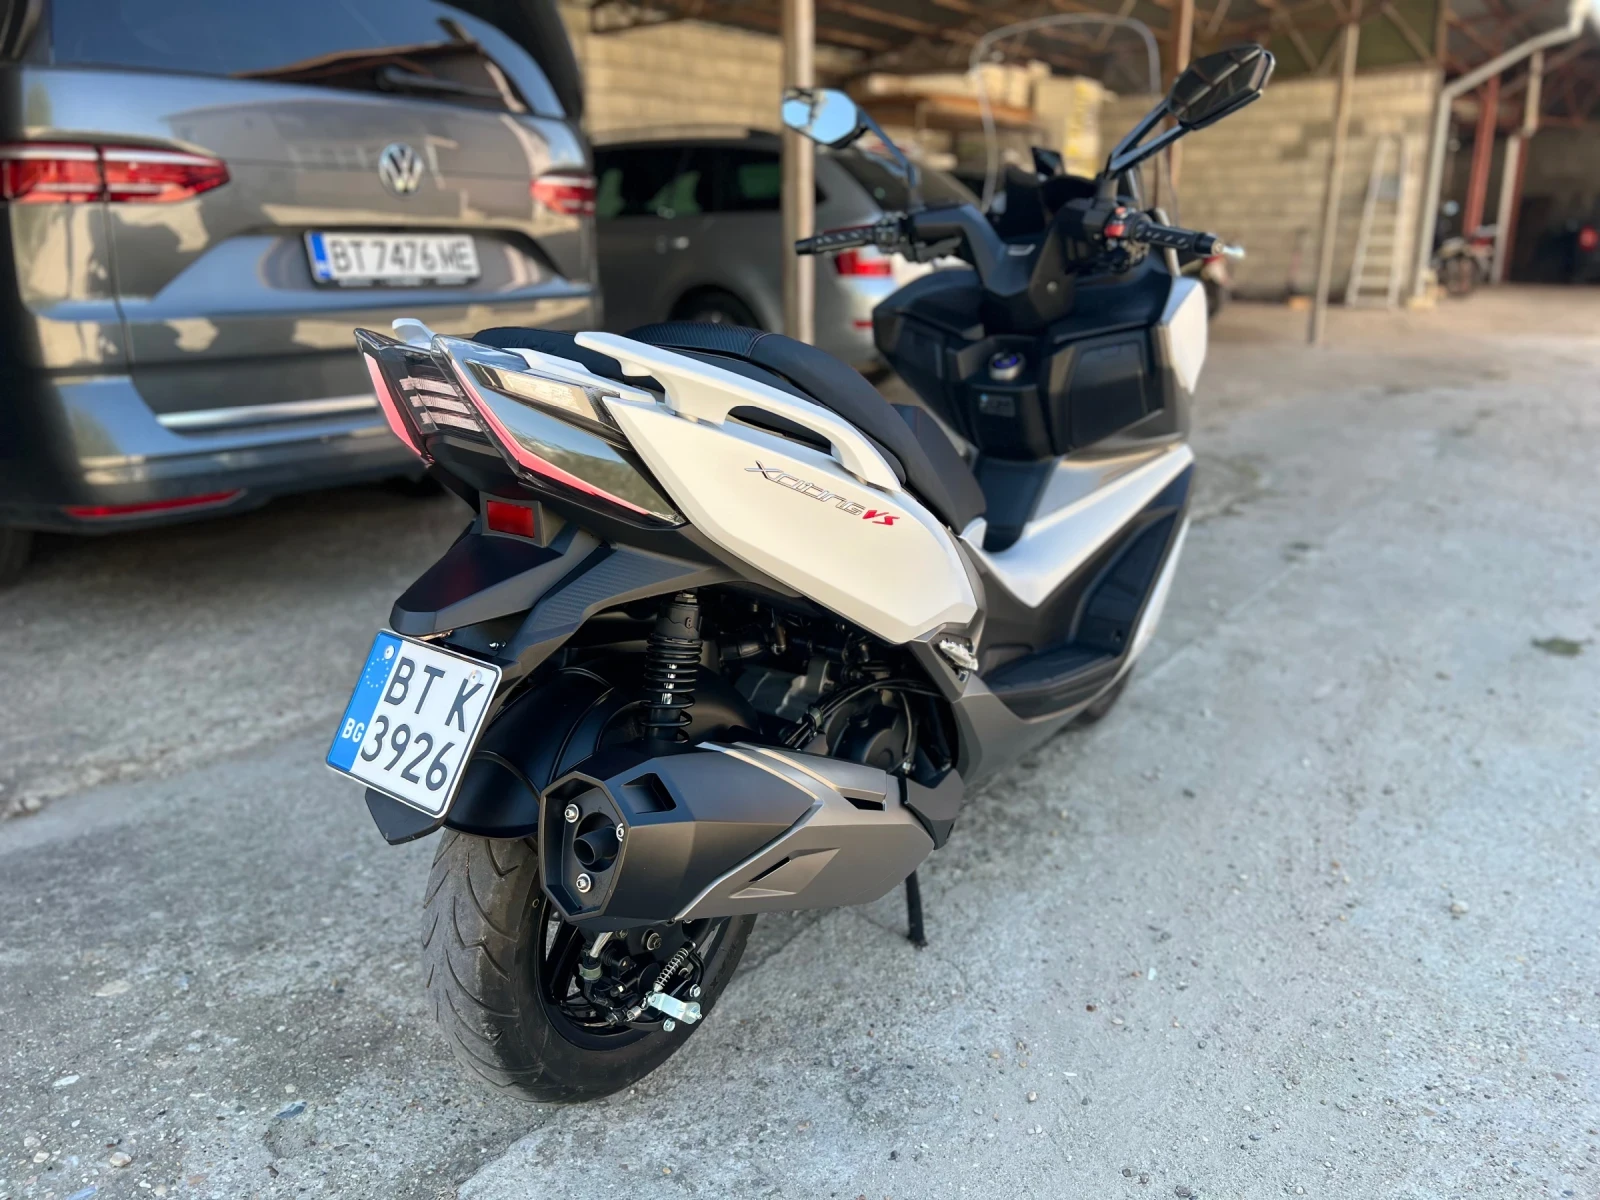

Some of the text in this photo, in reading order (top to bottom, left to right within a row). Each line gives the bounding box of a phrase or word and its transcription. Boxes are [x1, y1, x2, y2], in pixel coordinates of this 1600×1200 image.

[862, 509, 900, 526] VS
[383, 656, 484, 733] BT K
[341, 717, 365, 743] BG
[360, 715, 455, 791] 3926
